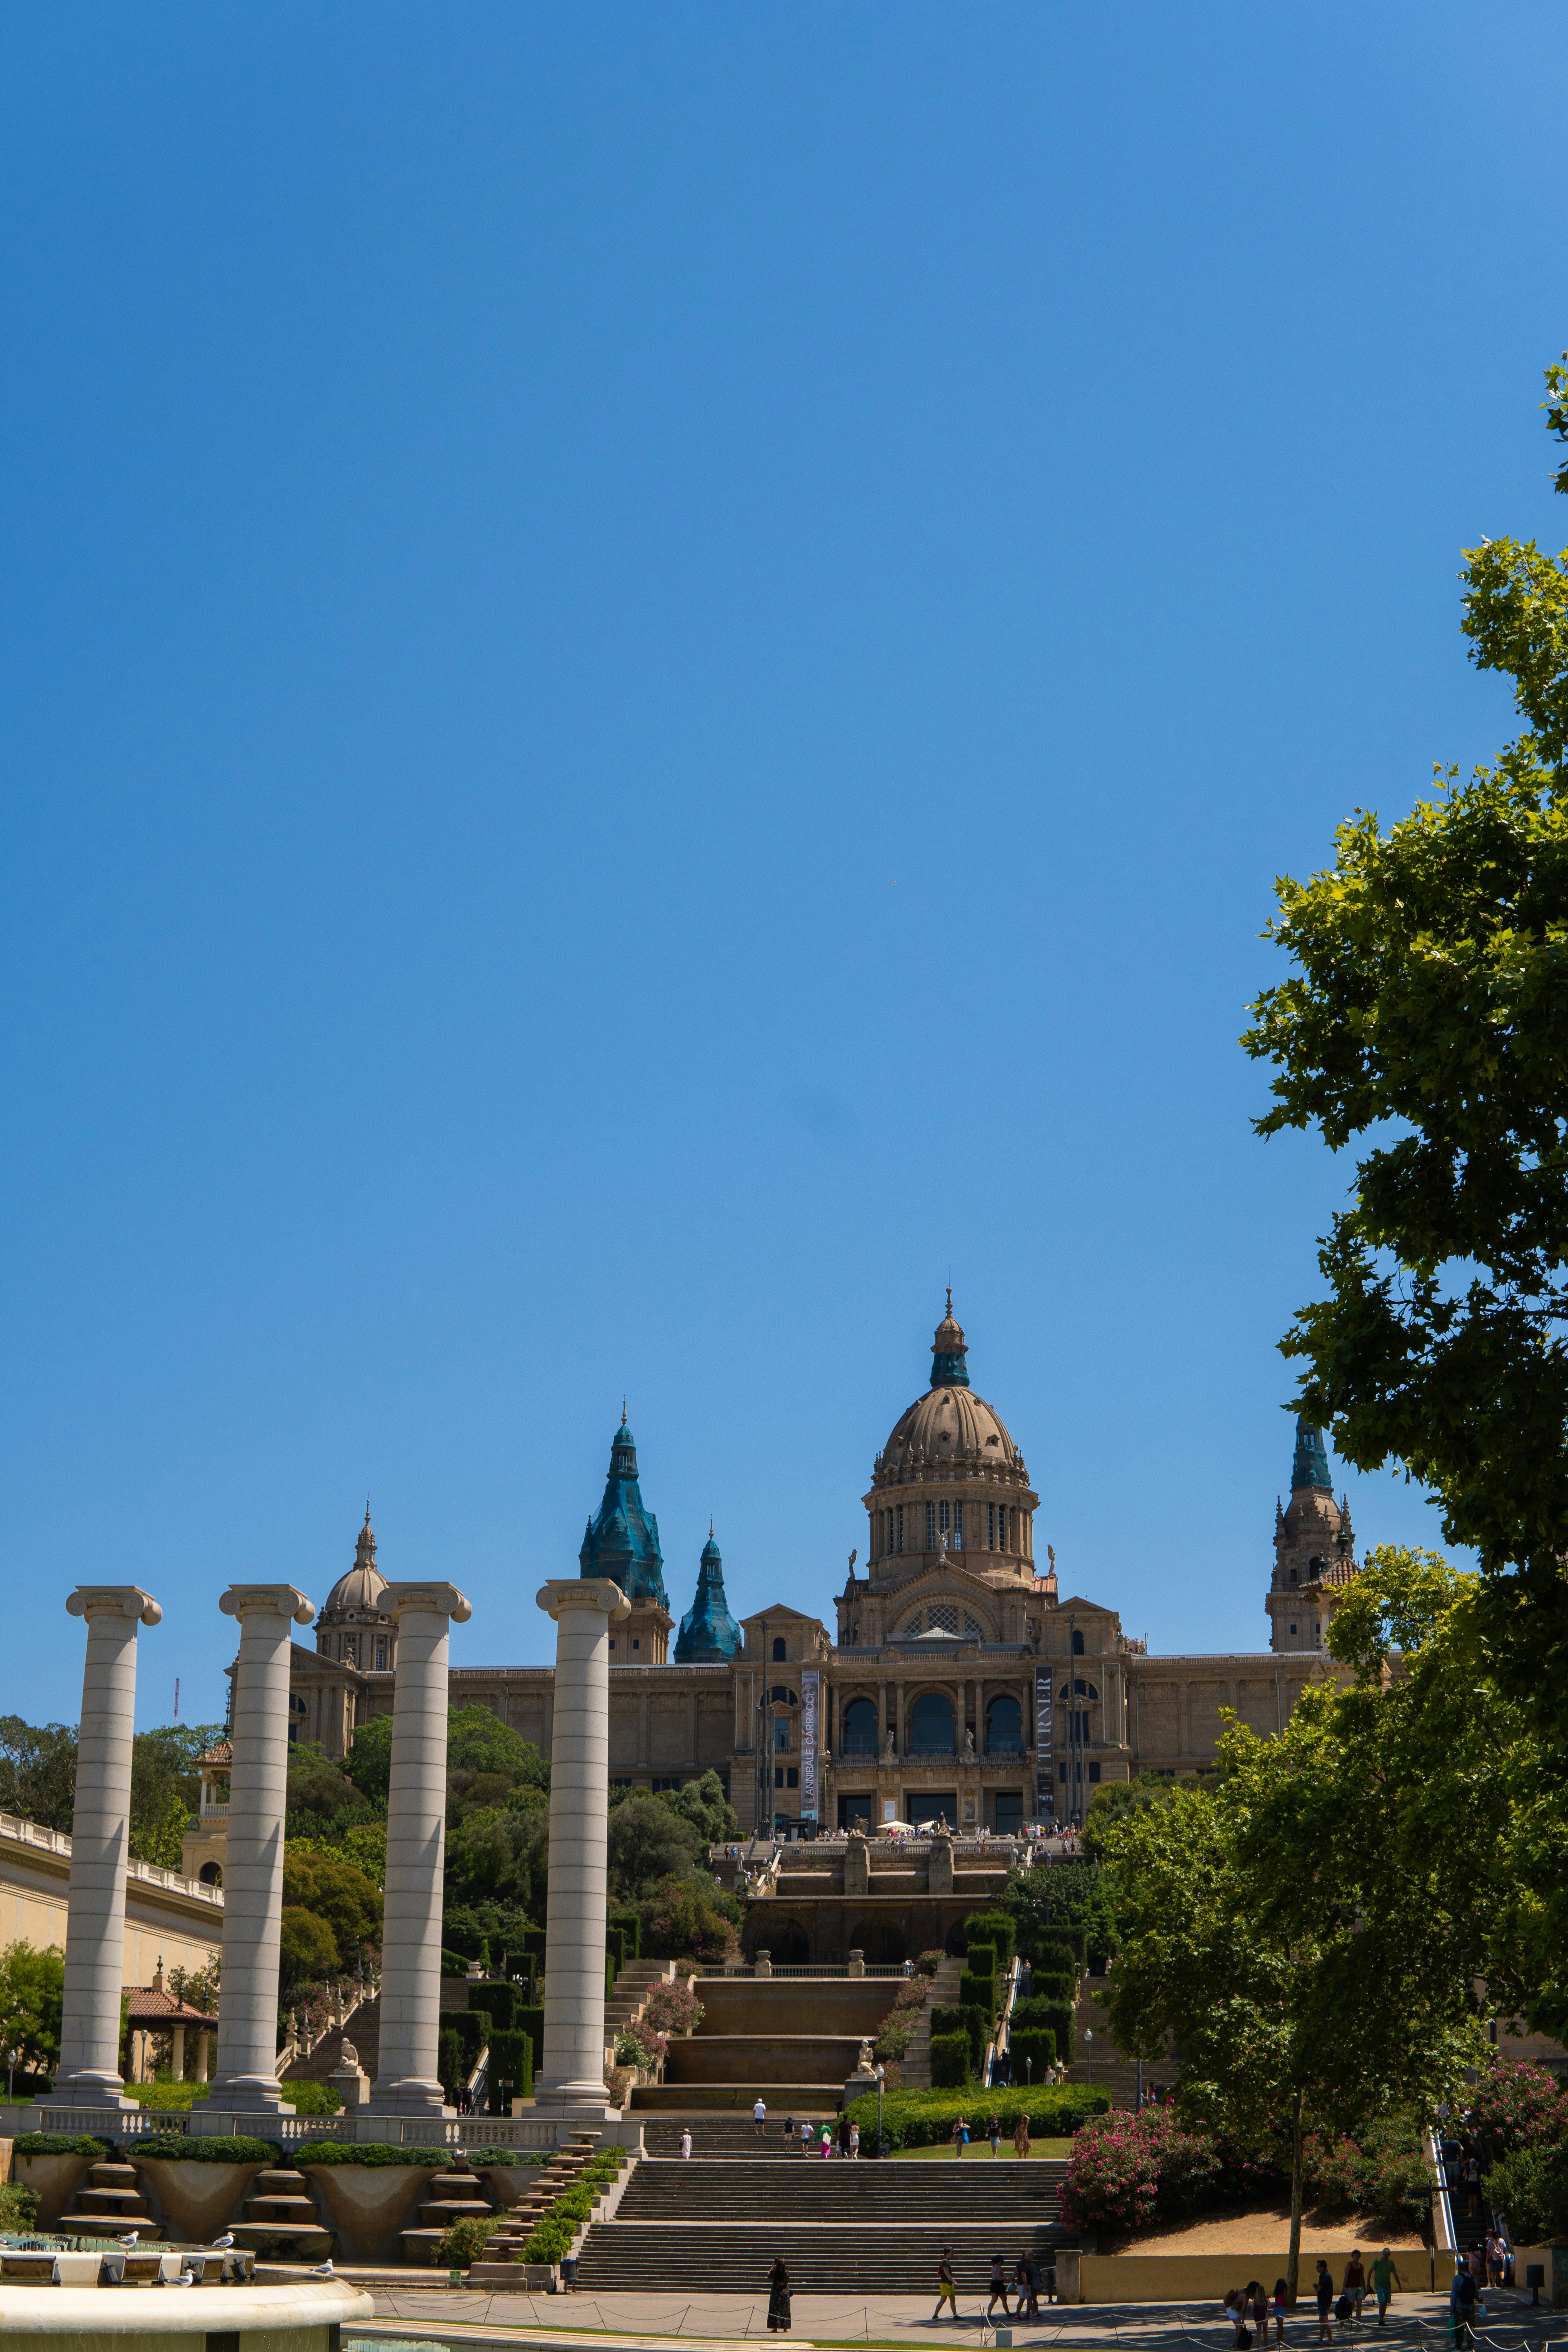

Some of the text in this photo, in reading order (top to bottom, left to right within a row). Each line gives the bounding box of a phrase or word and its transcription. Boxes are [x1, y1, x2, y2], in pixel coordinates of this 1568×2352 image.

[806, 1694, 814, 1745] CARRACCI
[1037, 1678, 1052, 1762] TURNER
[806, 1749, 814, 1796] ANNIBALE
